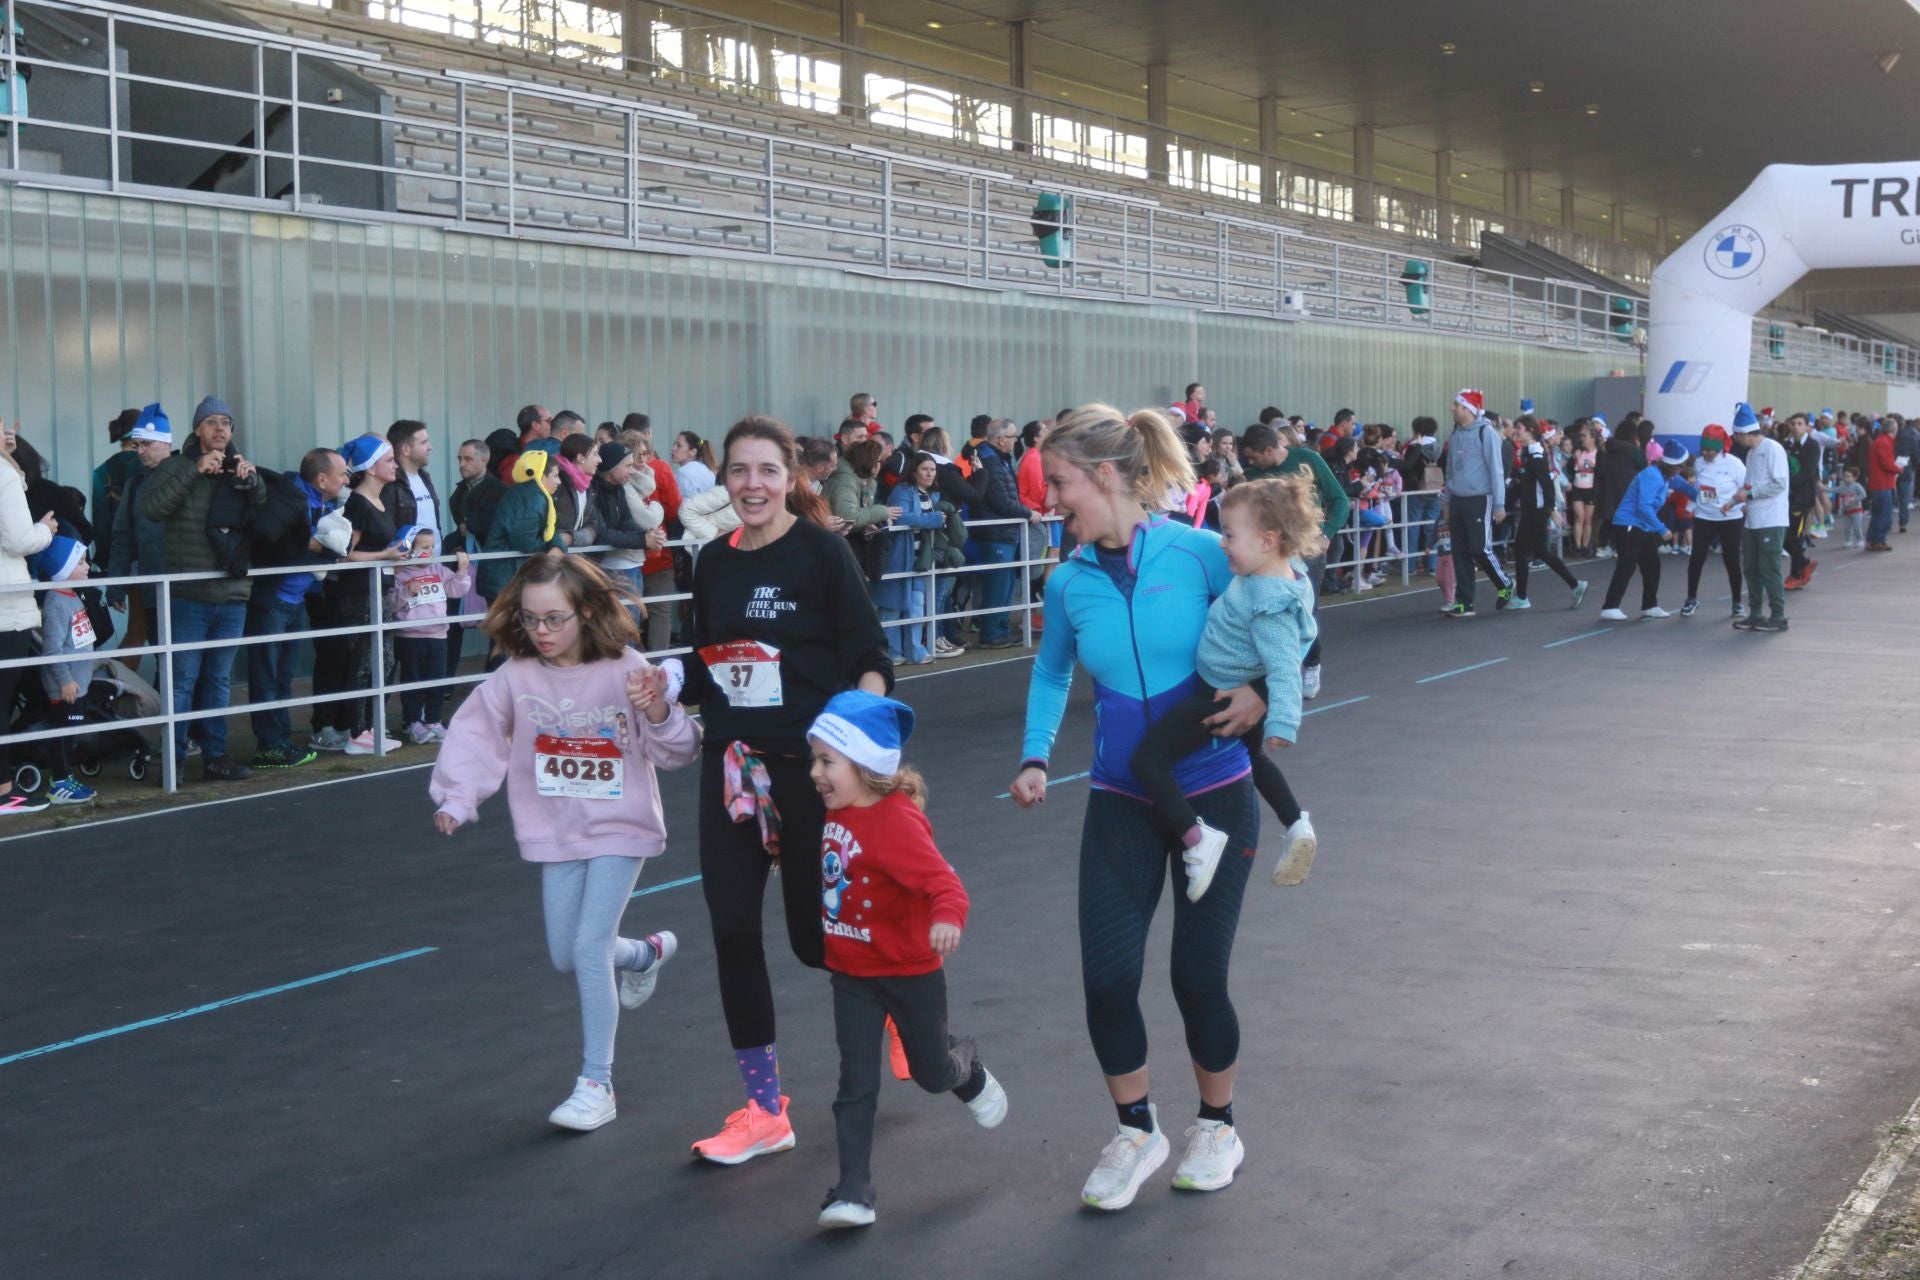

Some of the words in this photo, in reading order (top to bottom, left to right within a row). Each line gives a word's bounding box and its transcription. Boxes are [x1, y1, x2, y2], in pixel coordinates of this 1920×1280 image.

[1831, 177, 1920, 218] TR
[1714, 227, 1758, 242] BMW
[753, 586, 781, 599] TRC
[751, 600, 771, 610] THE
[774, 601, 797, 611] RUN
[749, 609, 777, 619] CLUB
[730, 665, 754, 688] 37
[544, 756, 616, 781] 4028
